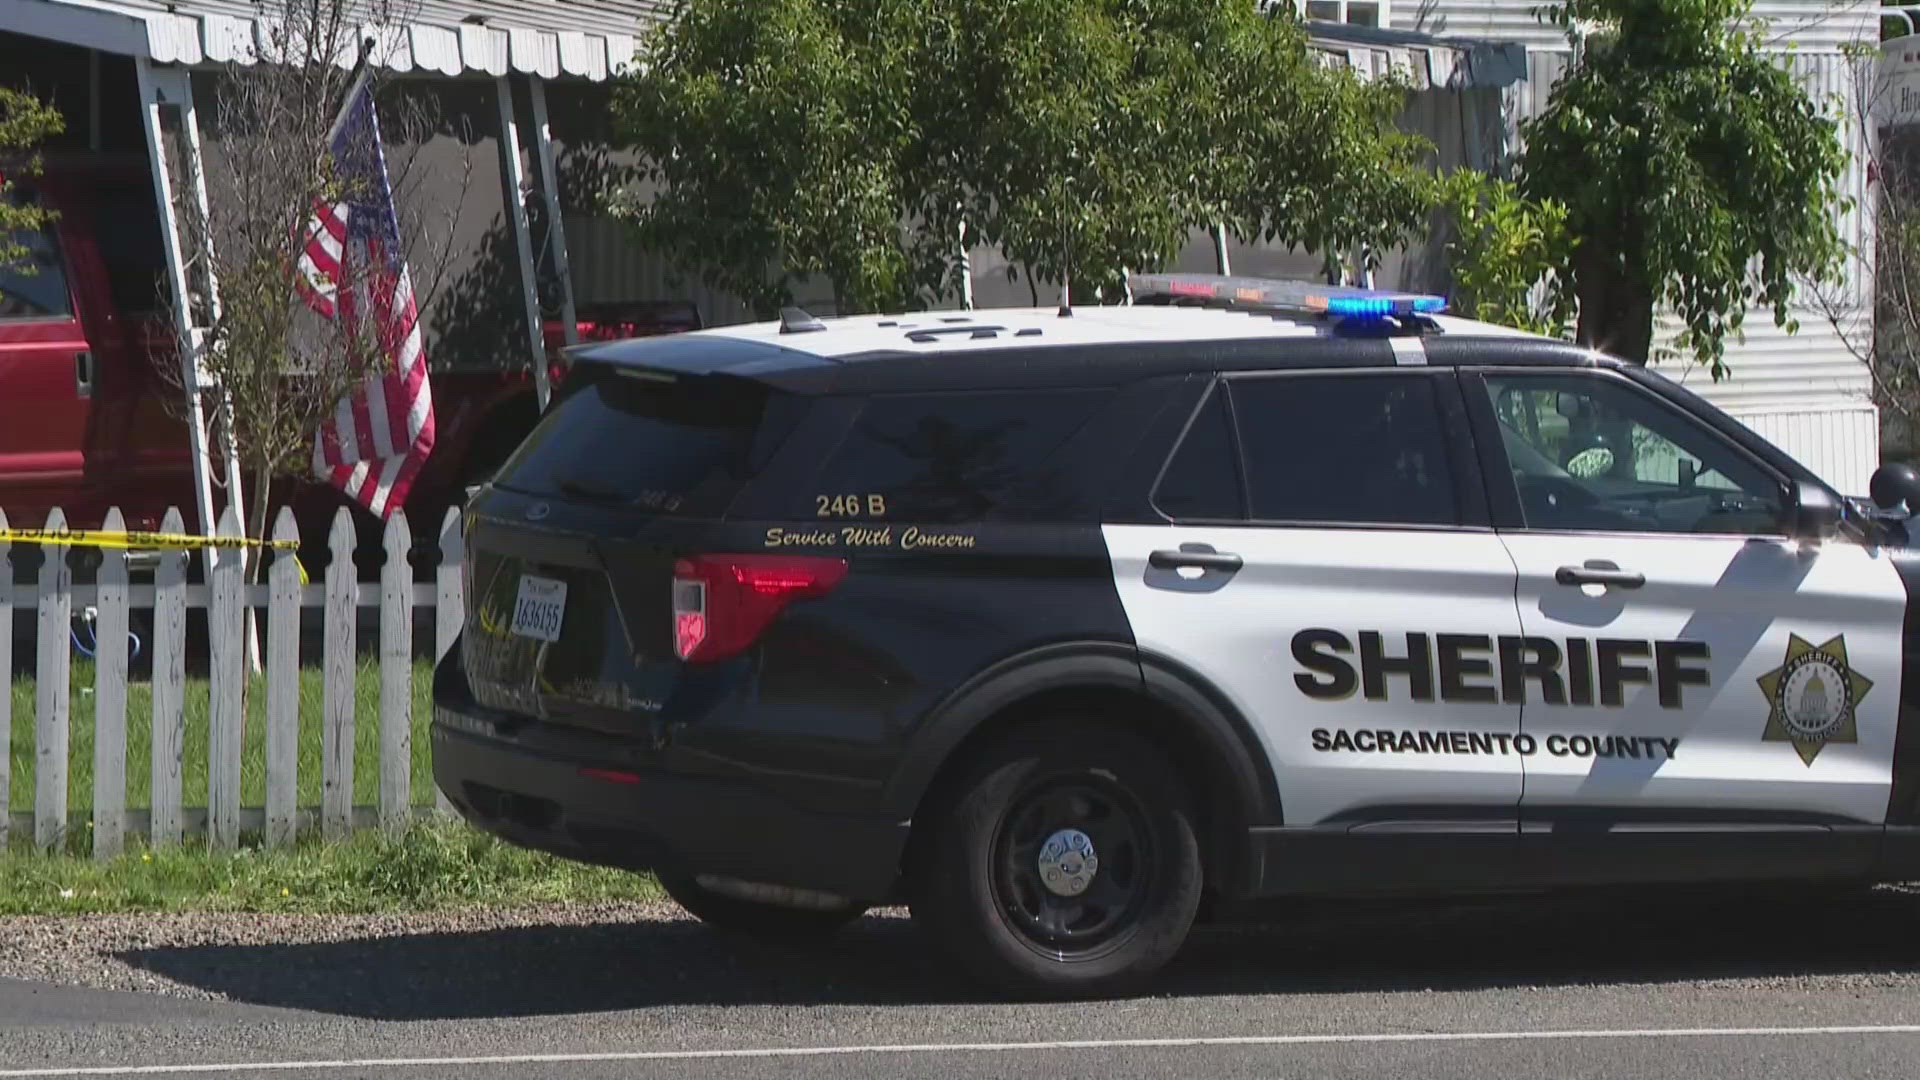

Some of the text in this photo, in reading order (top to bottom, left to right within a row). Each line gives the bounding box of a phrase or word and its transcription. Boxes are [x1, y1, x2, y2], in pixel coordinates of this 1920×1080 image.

[815, 494, 886, 517] 246 B
[764, 526, 976, 550] Service With Concern
[515, 598, 560, 632] 1636155
[1290, 627, 1711, 709] SHERIFF
[1794, 652, 1840, 668] SHERIFF
[1311, 727, 1680, 760] SACRAMENTO COUNTY
